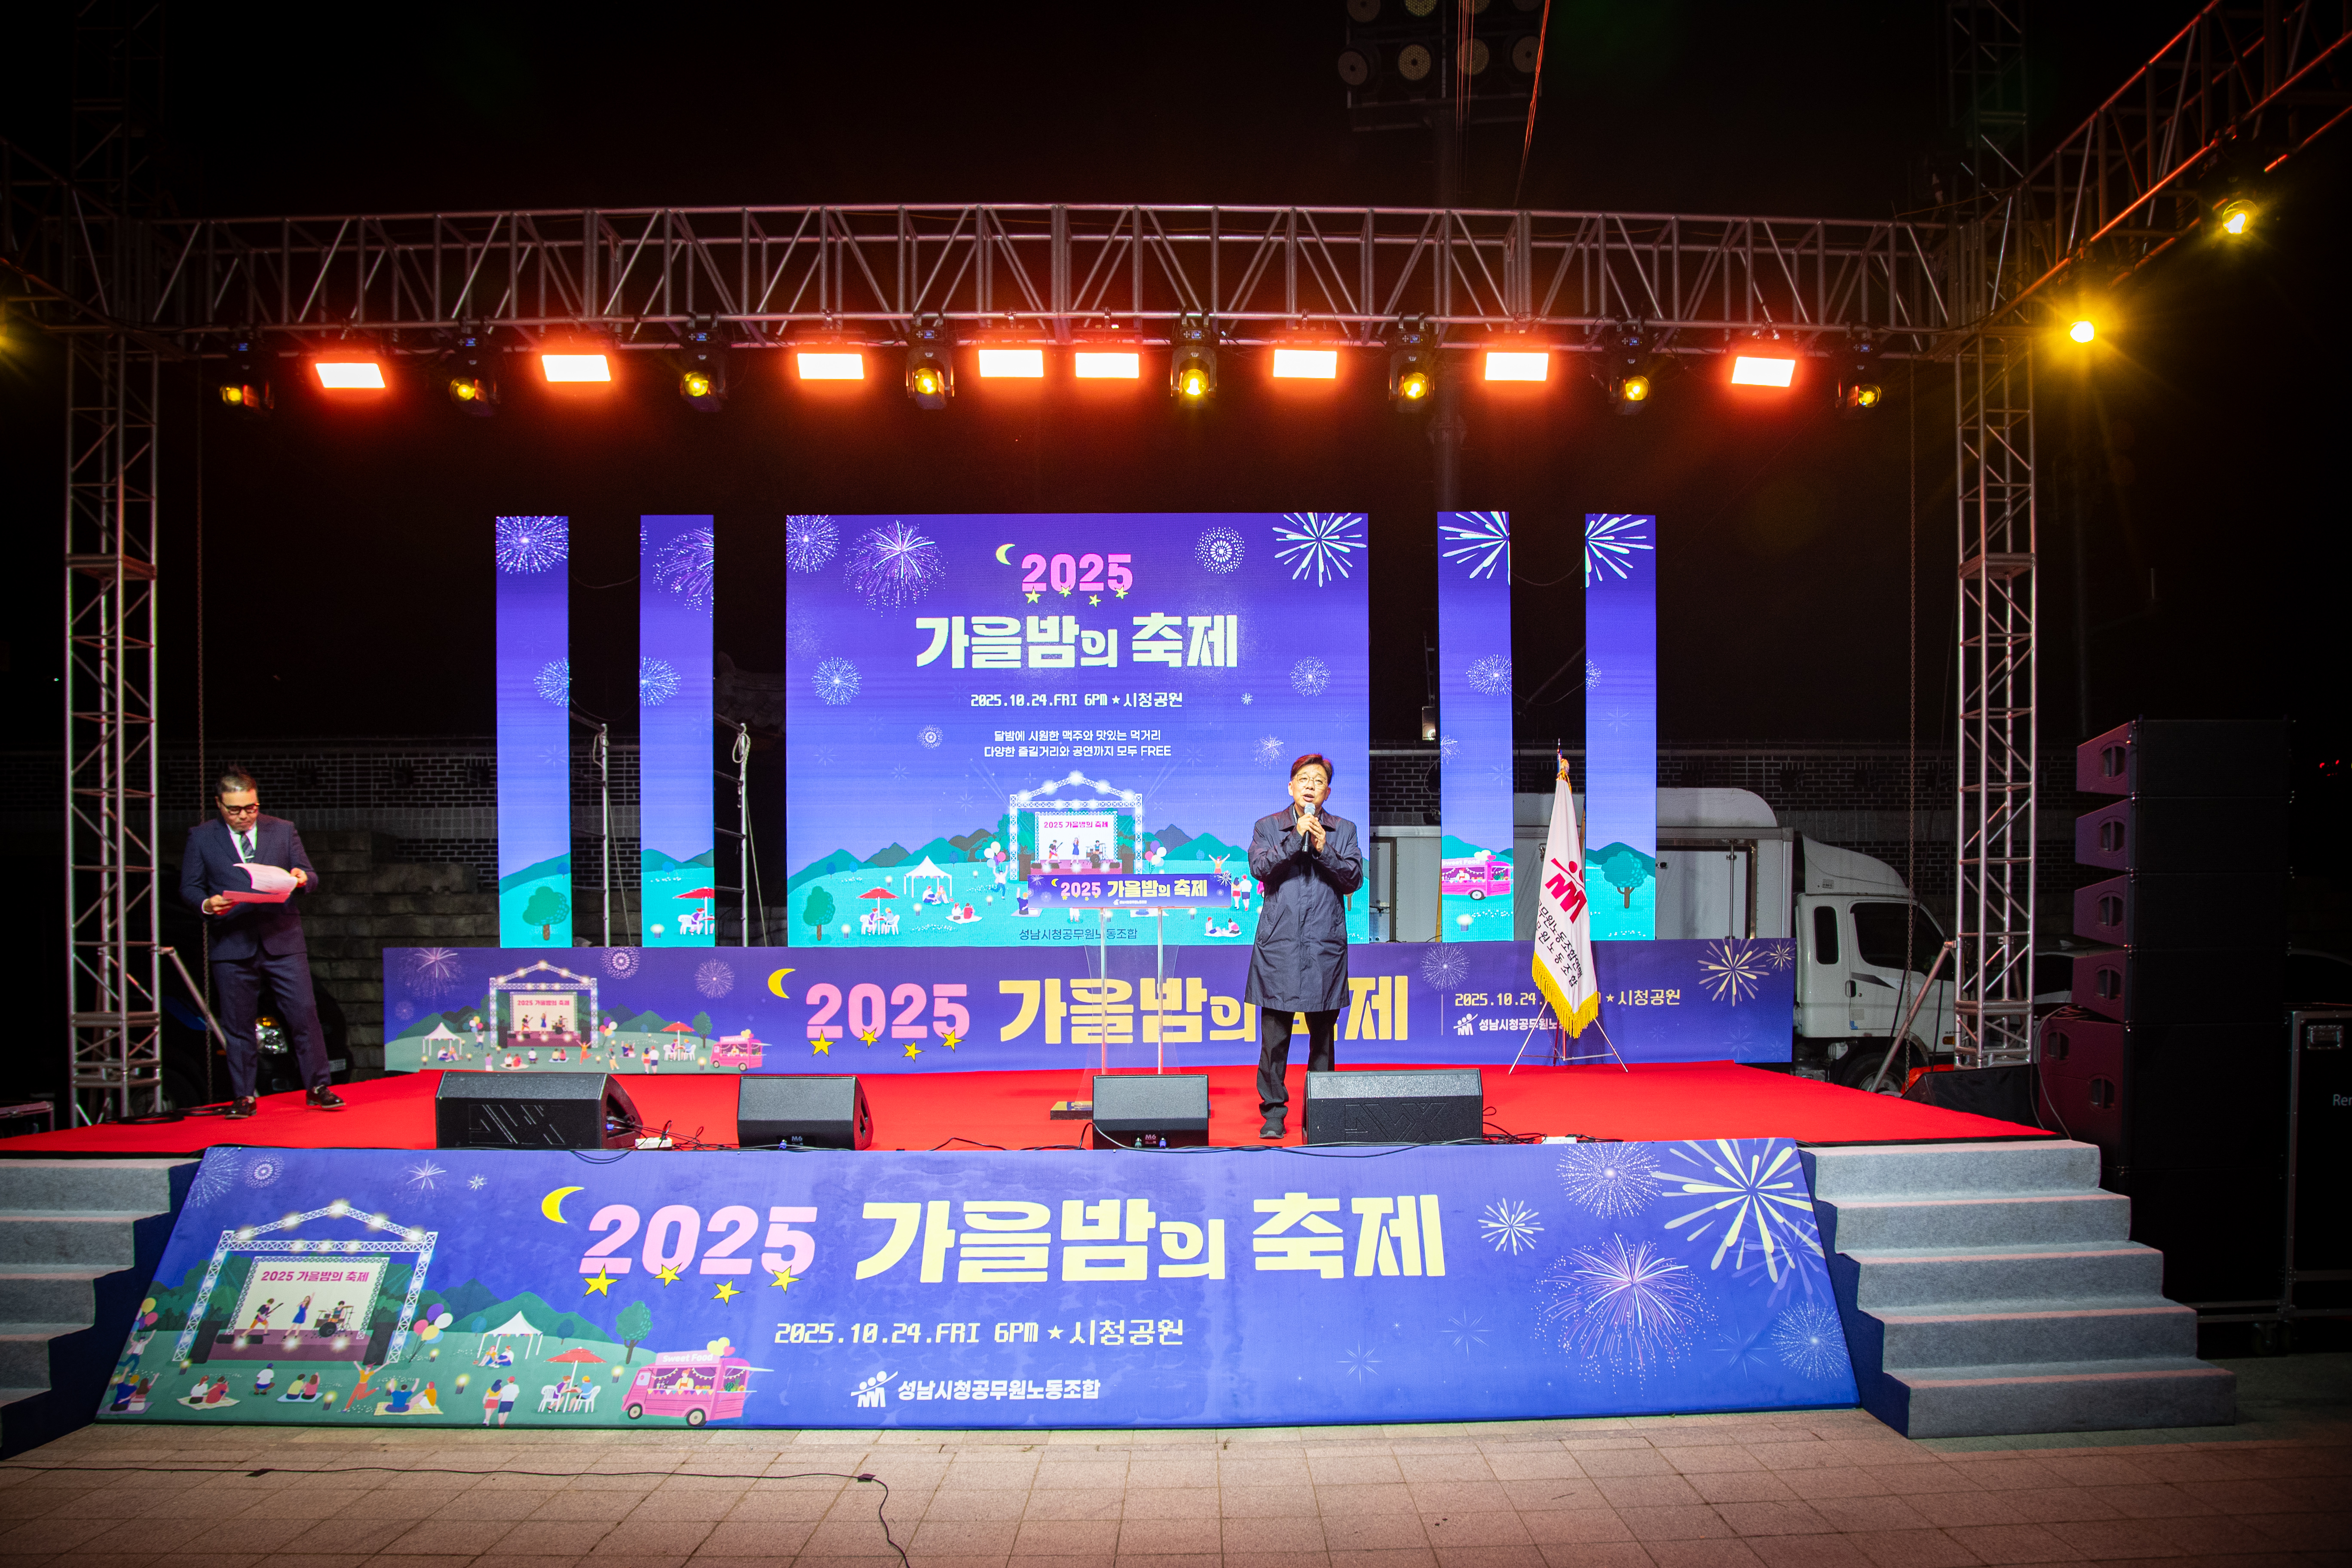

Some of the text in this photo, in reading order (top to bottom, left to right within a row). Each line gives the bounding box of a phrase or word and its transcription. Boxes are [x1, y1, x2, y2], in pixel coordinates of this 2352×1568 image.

[1021, 553, 1133, 592] 2025
[915, 612, 1238, 669] 가을밤의 축제
[971, 692, 1183, 707] 2025.10.24.FRI 6PM 시청공원
[994, 729, 1161, 741] 달밤에 시원한 맥주와 맛있는 먹거리
[984, 745, 1171, 757] 다양한 즐길거리와 공연까지 모두 FREE
[1060, 879, 1208, 897] 2025 가을밤의 축제
[1019, 928, 1138, 940] 성남시청공무원노동조합
[1538, 899, 1583, 979] 무원노동조합연맹
[1618, 989, 1680, 1006] 시청공원
[806, 983, 970, 1038] 2025
[999, 975, 1408, 1044] 가을밤의 제
[579, 1192, 1446, 1283] 2025 가을밤의 축제
[261, 1271, 370, 1282] 2025 가을밤의 축제
[775, 1319, 1183, 1345] 2025.10.24.FRI 6PM 시청공원
[662, 1353, 714, 1363] Sweet Food
[897, 1379, 1101, 1401] 성남시청공무원노동조합
